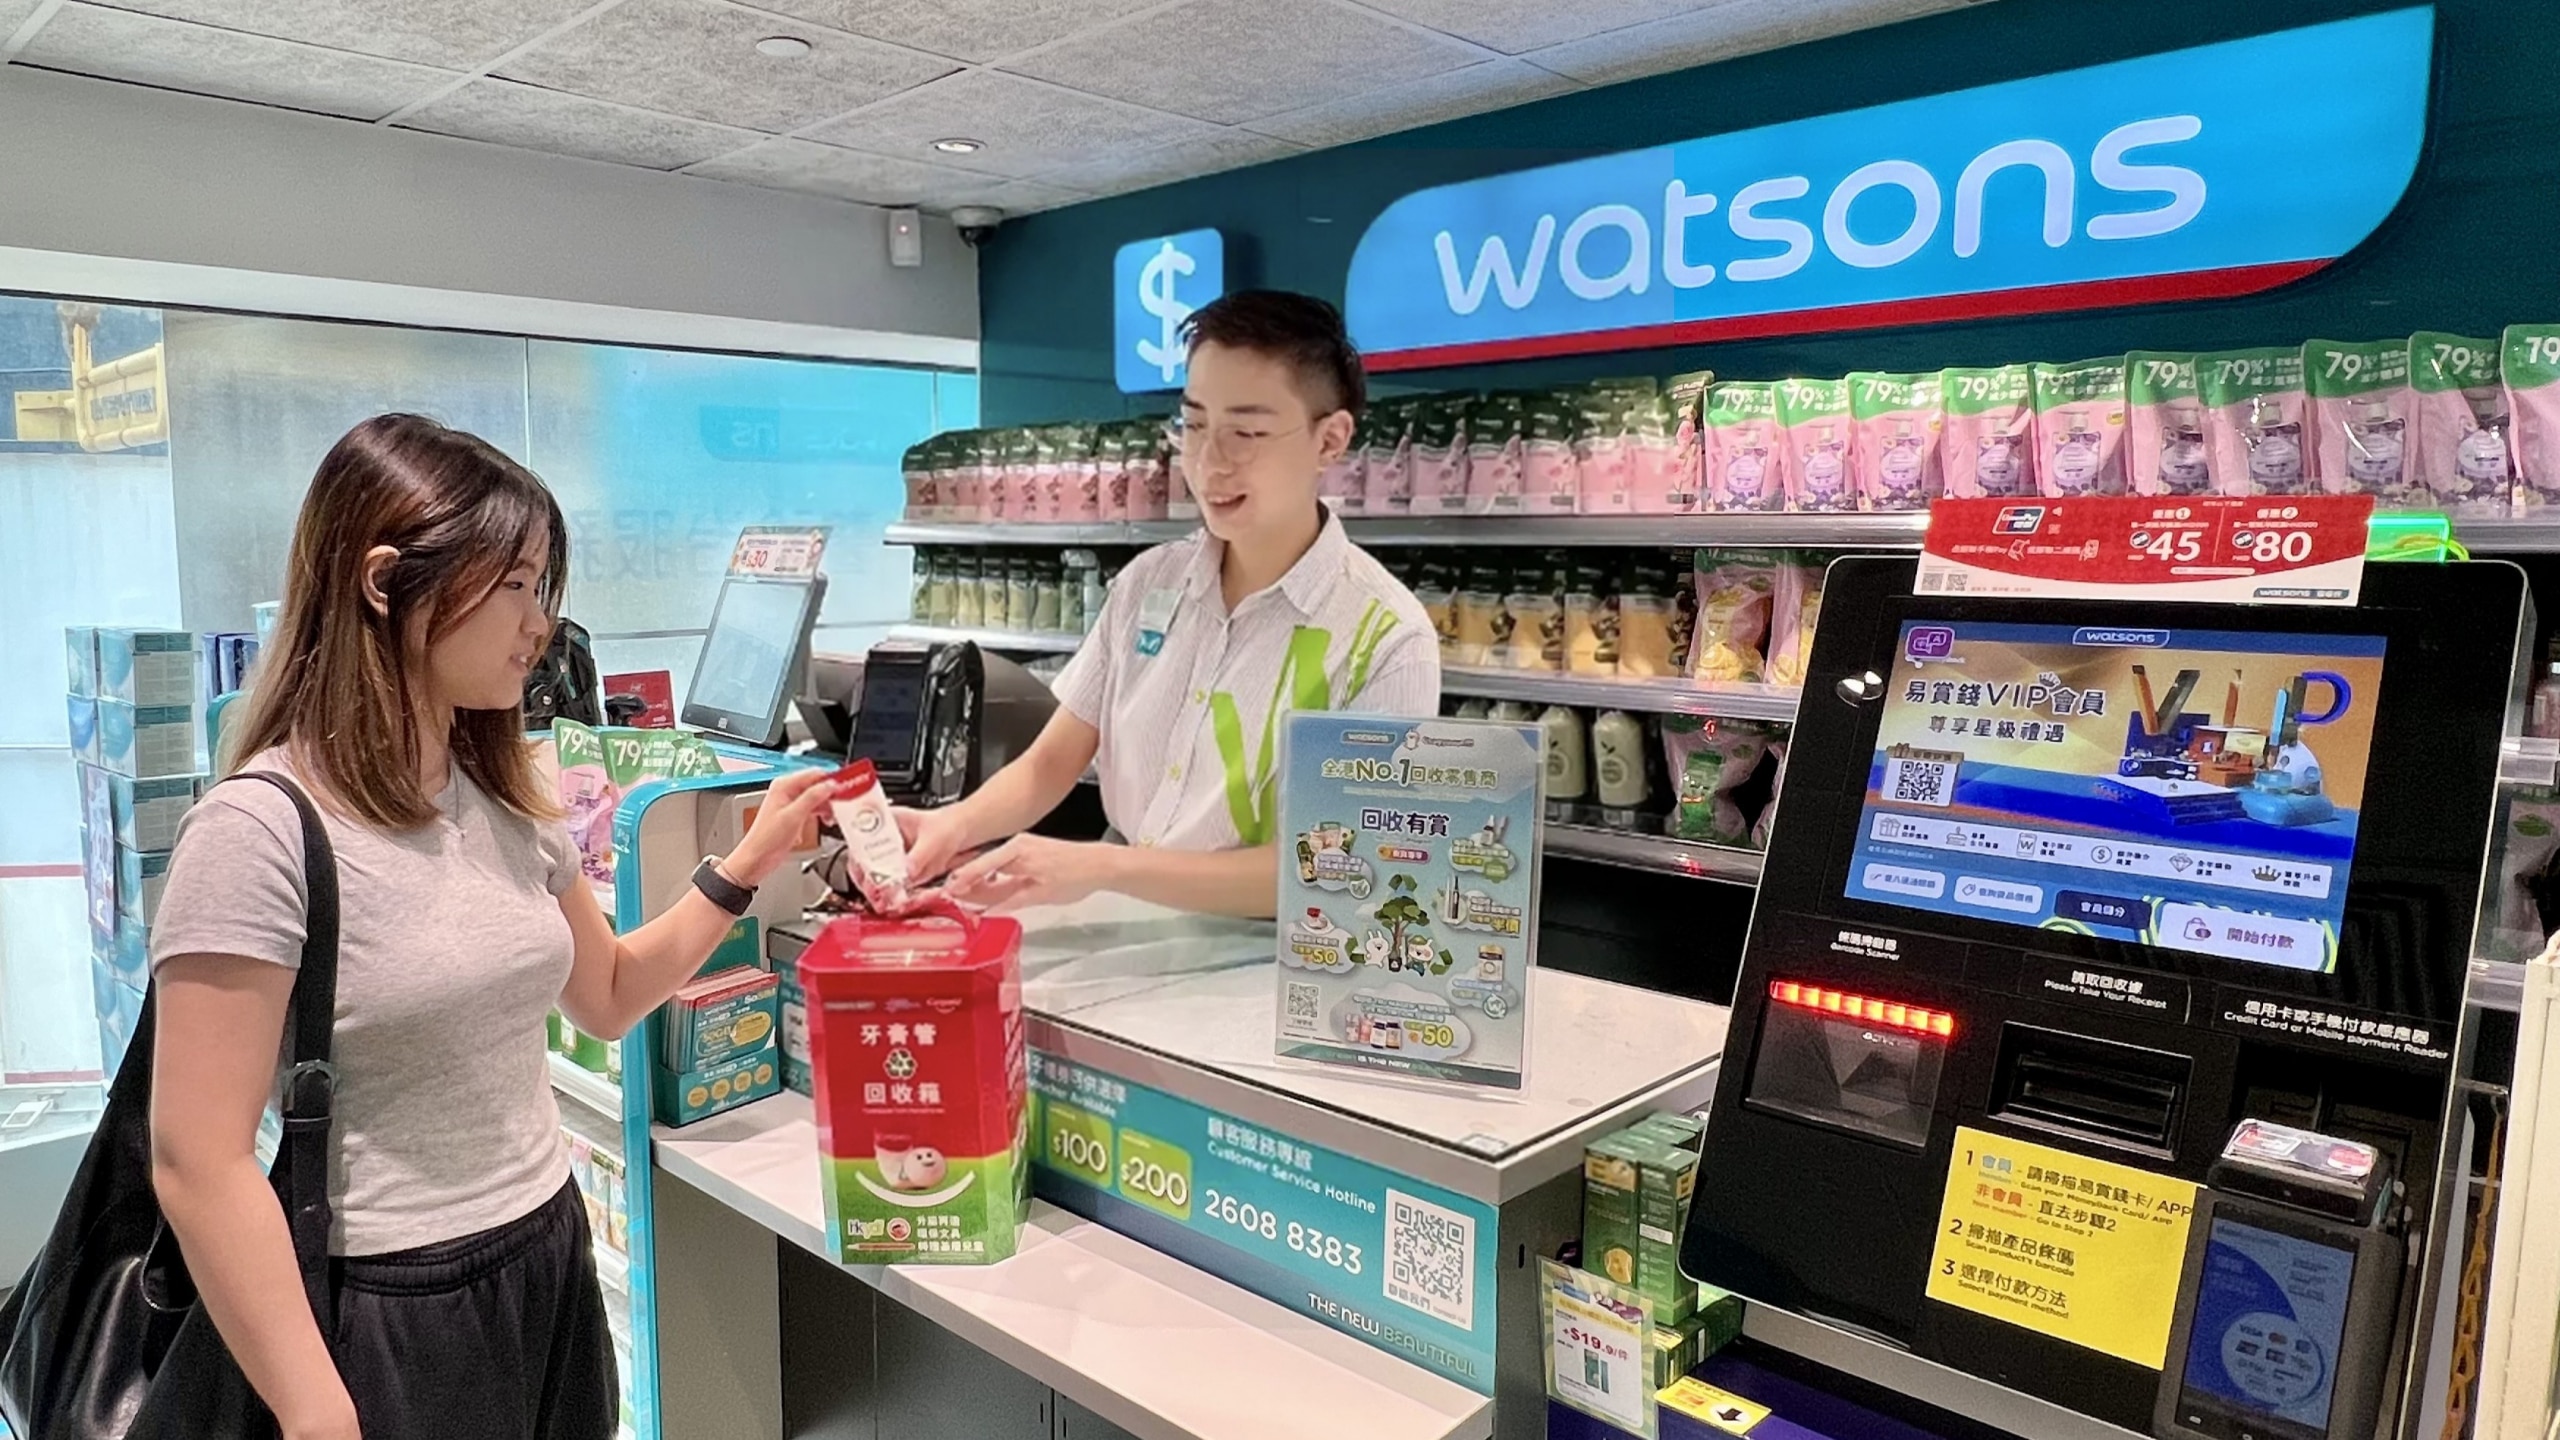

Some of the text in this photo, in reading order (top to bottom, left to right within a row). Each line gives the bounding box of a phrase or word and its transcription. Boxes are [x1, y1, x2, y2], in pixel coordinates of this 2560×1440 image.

[1434, 115, 2207, 315] watsons
[2146, 531, 2202, 562] 45
[2252, 531, 2312, 562] 80
[2259, 588, 2310, 597] watsons
[2086, 631, 2156, 643] watsons
[1905, 681, 2105, 716] 易賞錢VIP會員
[1928, 715, 2066, 743] 尊享星級禮遇
[1361, 808, 1450, 837] 回收有賞
[2227, 927, 2295, 949] 開始付款
[1313, 947, 1338, 966] 50
[2044, 978, 2167, 1010] Please Take Your Receipt
[1422, 1025, 1453, 1048] 50
[2224, 1011, 2449, 1060] Credit Card or Mobile payment Reader
[2244, 1000, 2430, 1045] 信用卡或手機付款感應器
[864, 1082, 941, 1105] 回收箱
[1053, 1128, 1107, 1173] $100
[1121, 1156, 1188, 1206] $200
[1208, 1141, 1376, 1213] Customer Service Hotline
[1965, 1150, 1974, 1166] 1
[2156, 1200, 2193, 1218] APP
[2020, 1181, 2043, 1194] Scan
[2044, 1188, 2066, 1199] your
[1975, 1183, 2117, 1233] 非會員 直去步驟2
[2036, 1215, 2050, 1226] Go
[2063, 1223, 2085, 1237] Step
[1204, 1189, 1362, 1275] 2608 8383
[1949, 1218, 2076, 1267] 2 掃描產品條碼
[1965, 1239, 2075, 1277] Scan product's barcode
[1941, 1258, 2067, 1309] 3 選擇付款方法
[1958, 1279, 2069, 1320] Select payment method
[1307, 1293, 1338, 1318] THE
[1383, 1326, 1478, 1379] BEAUTIFUL
